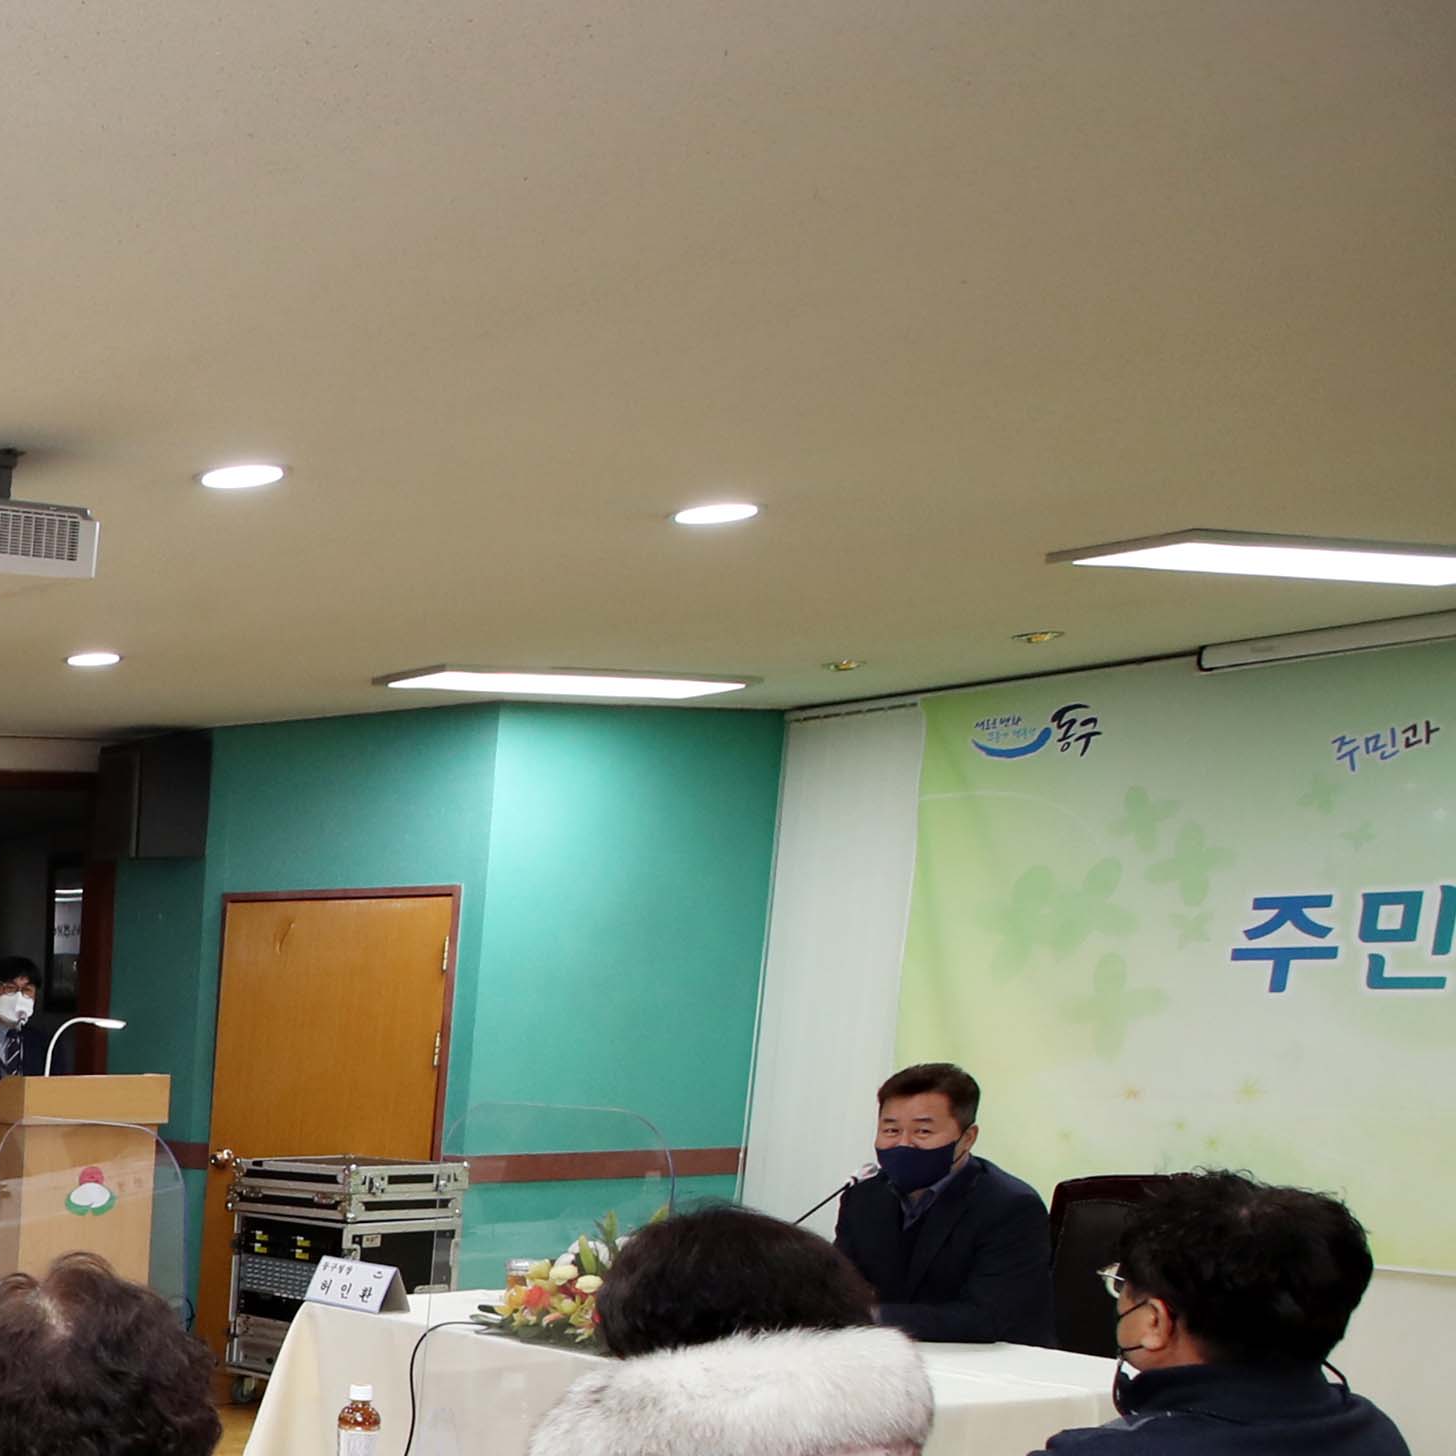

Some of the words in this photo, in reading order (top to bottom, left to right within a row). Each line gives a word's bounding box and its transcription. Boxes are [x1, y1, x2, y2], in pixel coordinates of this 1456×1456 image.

[1052, 704, 1103, 757] 동구
[1332, 720, 1441, 771] 주민과
[320, 1279, 373, 1302] 허인환
